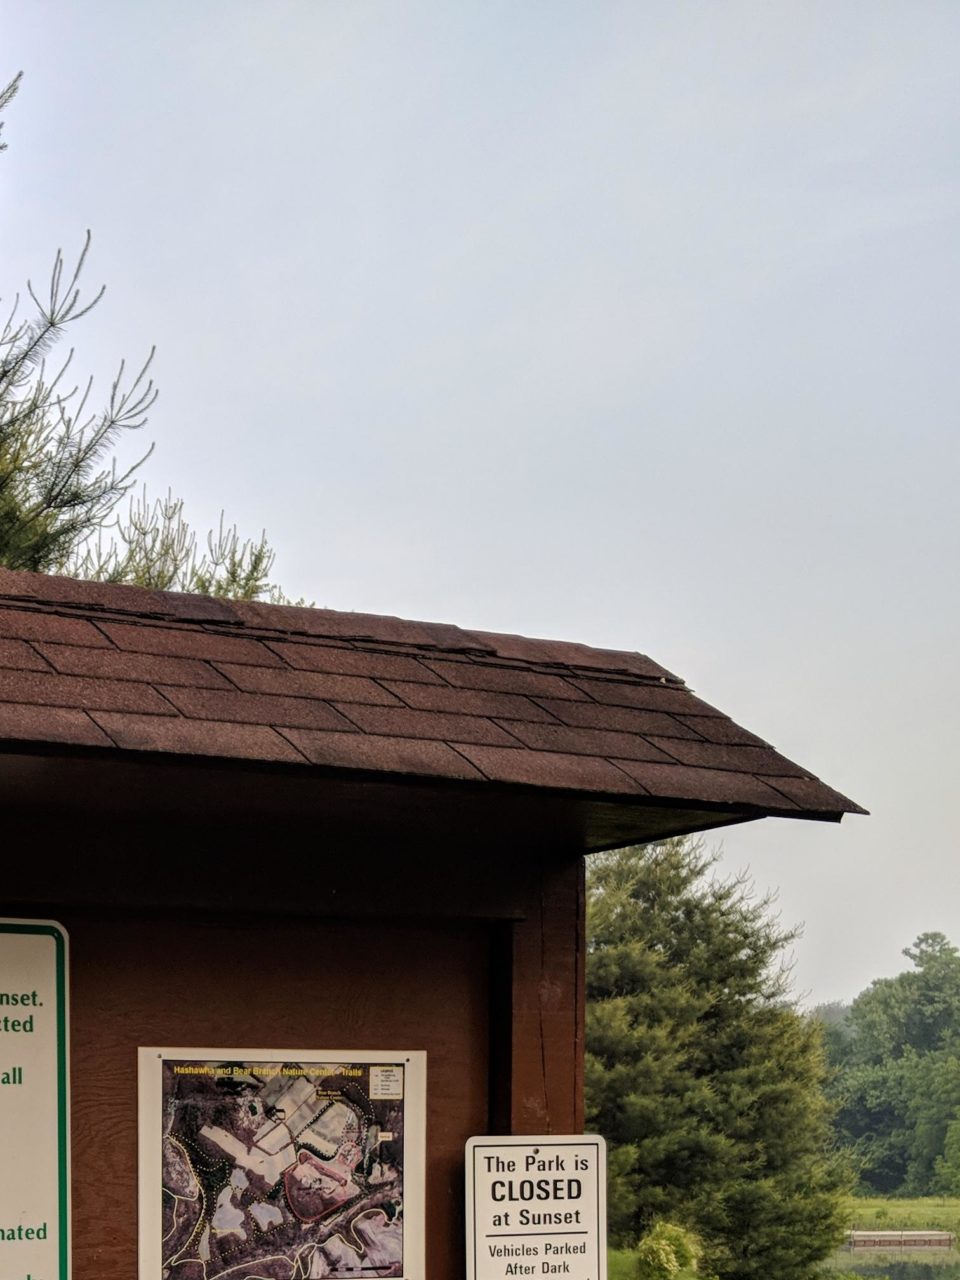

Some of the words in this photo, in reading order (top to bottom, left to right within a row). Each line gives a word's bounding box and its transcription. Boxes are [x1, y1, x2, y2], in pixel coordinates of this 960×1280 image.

[1, 1067, 22, 1085] all
[340, 1068, 362, 1077] Trails
[484, 1156, 516, 1173] The
[525, 1155, 565, 1172] Park
[575, 1154, 588, 1171] is
[491, 1179, 582, 1202] CLOSED
[493, 1212, 510, 1227] at
[519, 1209, 581, 1225] Sunset
[488, 1244, 539, 1257] Vehicles
[545, 1242, 586, 1255] Parked
[505, 1263, 536, 1275] After
[542, 1261, 570, 1274] Dark
